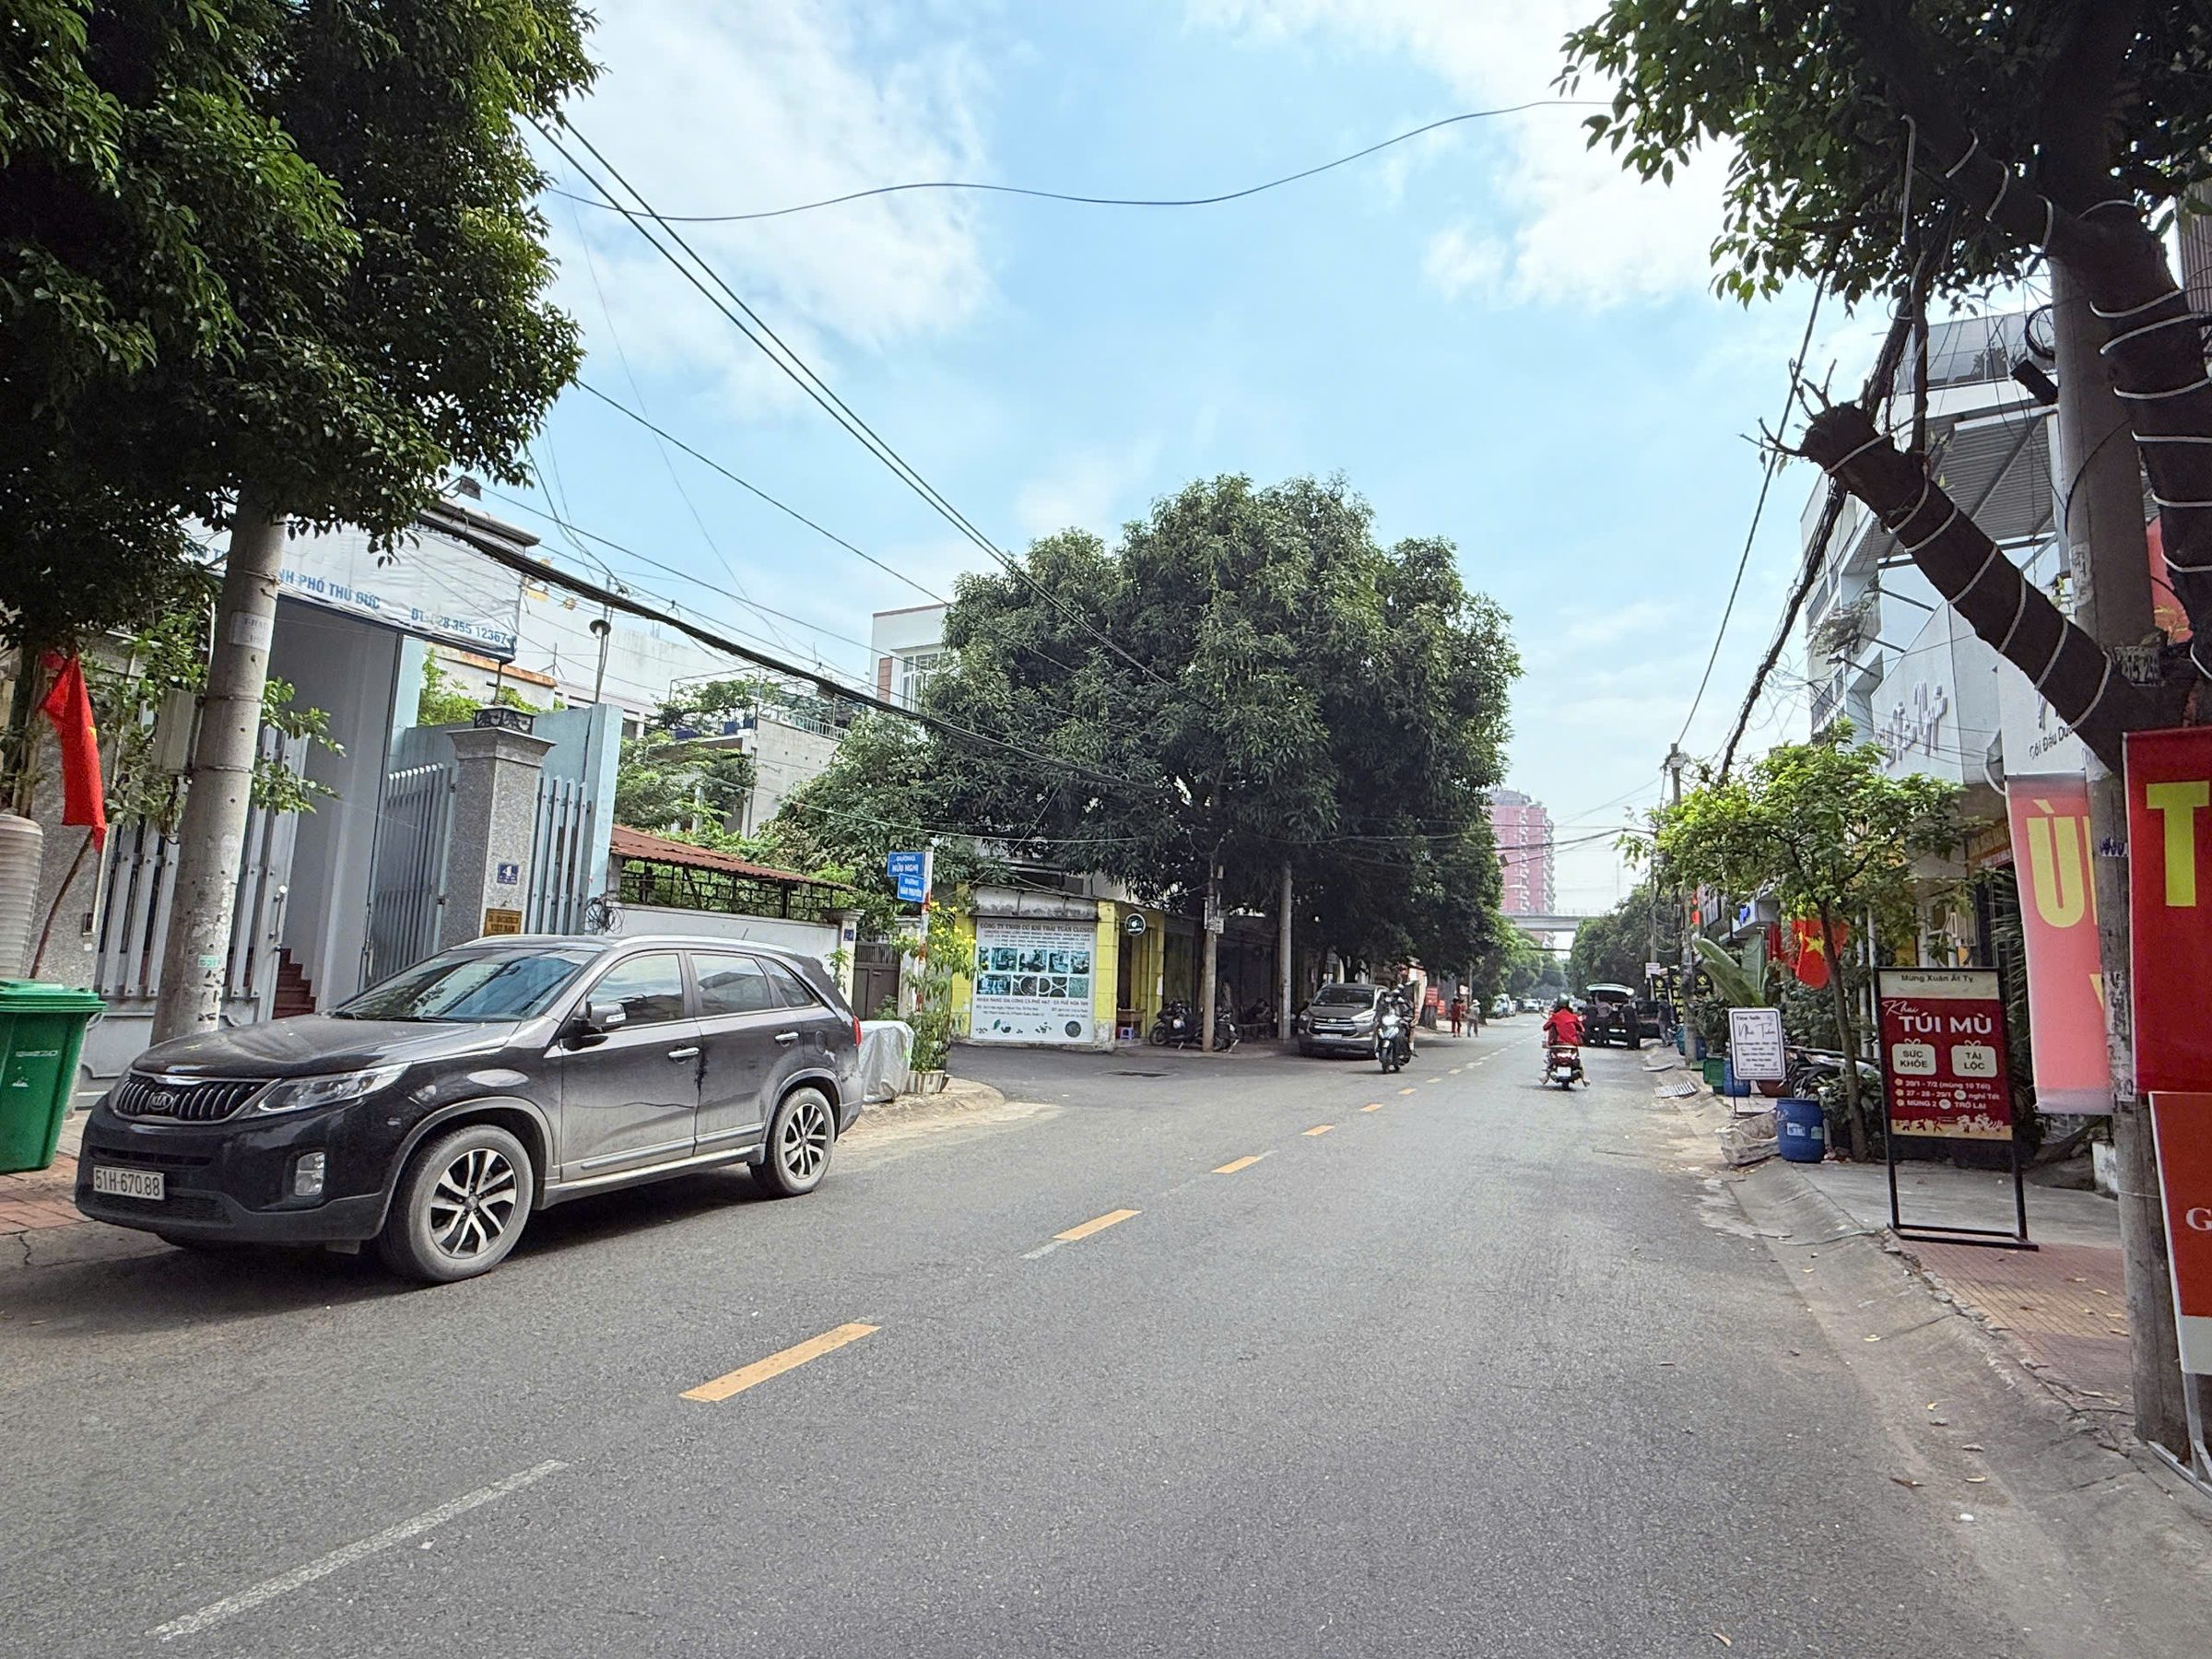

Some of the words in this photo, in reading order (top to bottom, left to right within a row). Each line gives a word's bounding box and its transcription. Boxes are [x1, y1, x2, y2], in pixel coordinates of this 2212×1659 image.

[299, 575, 324, 594] PHỐ
[1926, 974, 1949, 982] Xuân
[1898, 1012, 1942, 1033] TÚI
[1949, 1013, 1992, 1035] MÙ
[1902, 1050, 1924, 1058] SỨC
[1965, 1051, 1983, 1060] TÀI
[1963, 1060, 1986, 1071] LỘC
[152, 1095, 168, 1106] KIA
[94, 1170, 161, 1197] 51H-670.88
